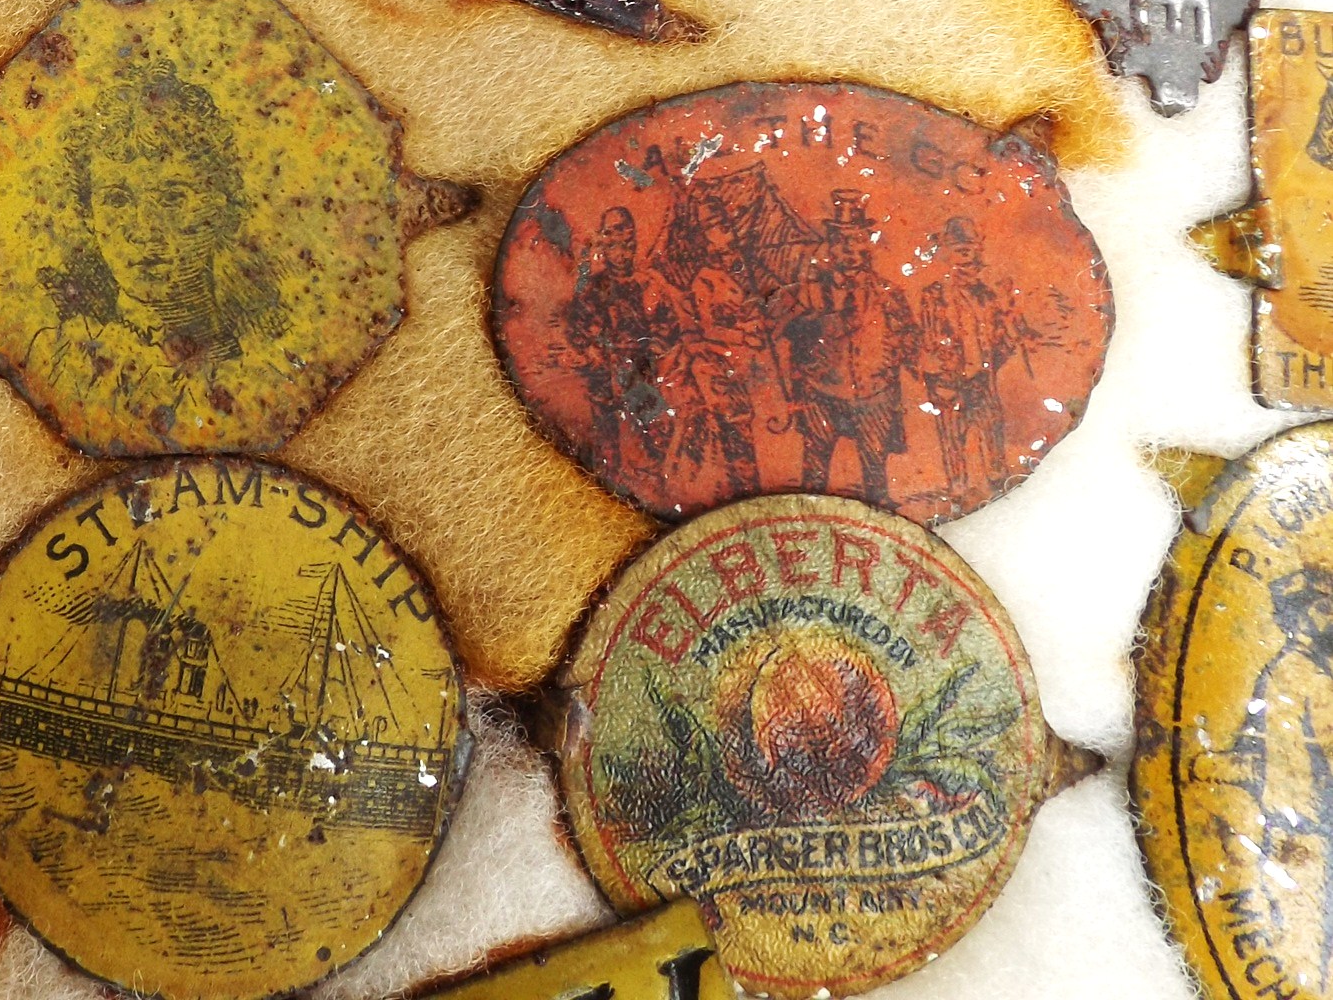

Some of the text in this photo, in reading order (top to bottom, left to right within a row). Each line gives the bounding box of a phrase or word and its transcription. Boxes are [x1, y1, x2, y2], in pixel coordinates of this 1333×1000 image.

[752, 113, 890, 163] THE
[629, 530, 972, 667] ELBERTA
[665, 829, 852, 892] SPARGER
